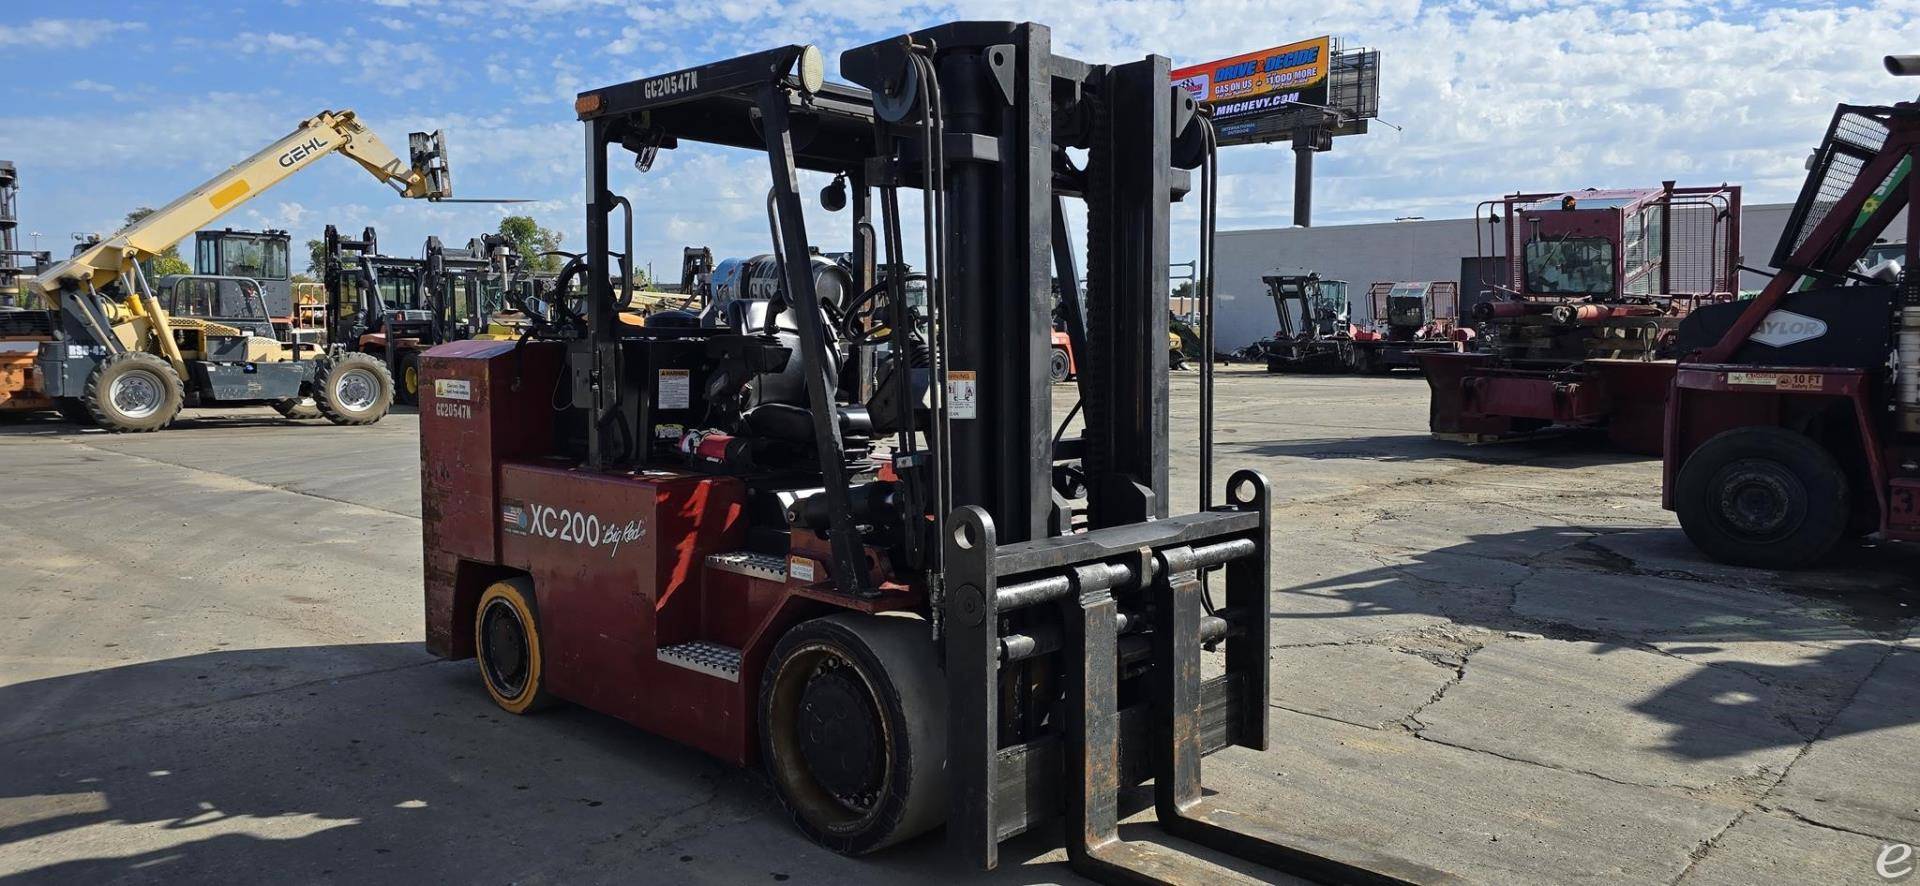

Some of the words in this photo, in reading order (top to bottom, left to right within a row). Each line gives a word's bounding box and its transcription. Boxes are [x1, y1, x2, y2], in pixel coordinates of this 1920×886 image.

[1214, 60, 1257, 82] DRIVE
[1265, 46, 1319, 72] DECIDE
[1293, 68, 1317, 79] MORE
[1215, 84, 1229, 95] GAS
[1230, 82, 1241, 92] ON
[1242, 79, 1253, 90] US
[279, 137, 328, 167] GEHL
[1753, 321, 1818, 335] AYLOR
[1792, 375, 1805, 384] 10
[1808, 375, 1821, 384] FT
